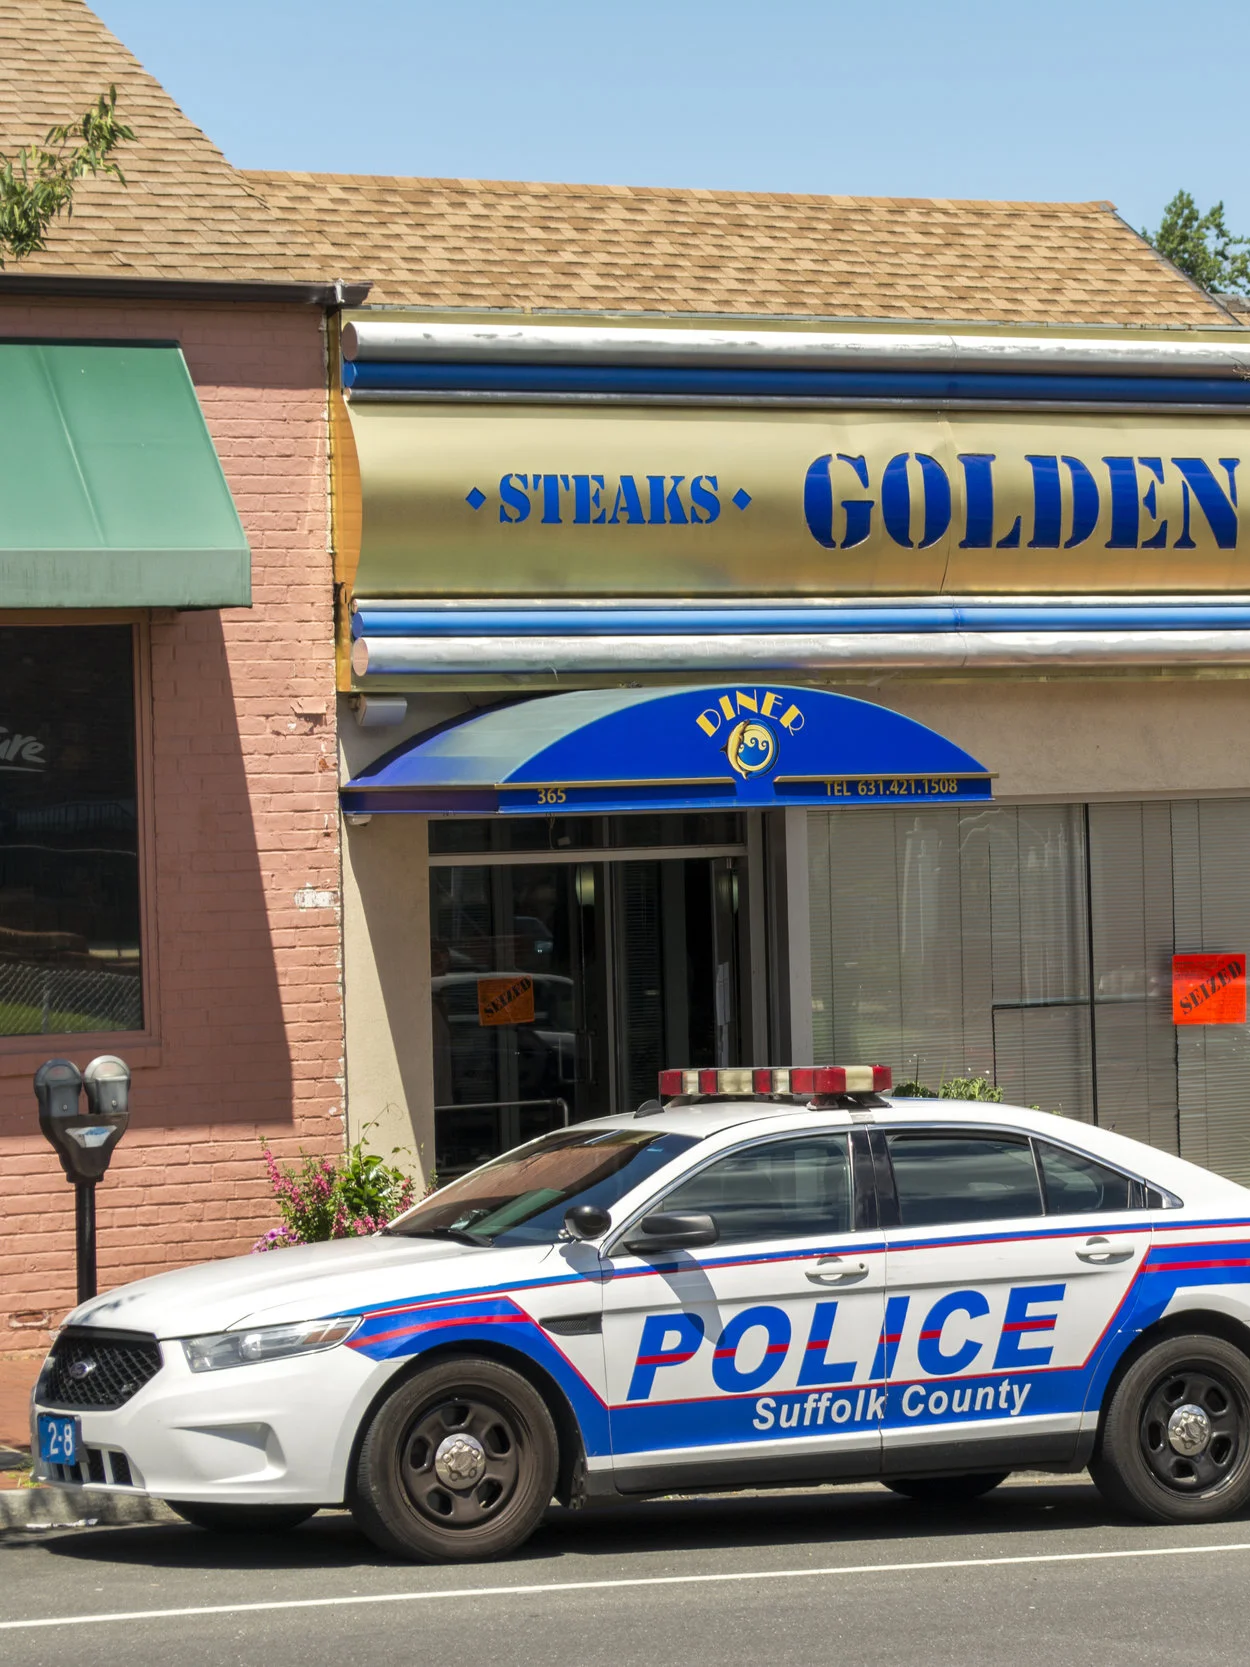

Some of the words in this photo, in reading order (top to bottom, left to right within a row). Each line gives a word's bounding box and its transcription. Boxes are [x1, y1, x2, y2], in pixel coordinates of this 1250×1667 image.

[499, 473, 722, 525] STEAKS
[803, 452, 1241, 550] GOLDEN
[695, 689, 805, 737] DINER
[537, 787, 567, 804] 365
[824, 781, 851, 797] TEL
[857, 778, 958, 797] 631.421.1508
[1180, 961, 1242, 1015] SEIZED
[626, 1283, 1067, 1401] POLICE
[752, 1392, 888, 1430] Suffolk
[902, 1379, 1032, 1417] County
